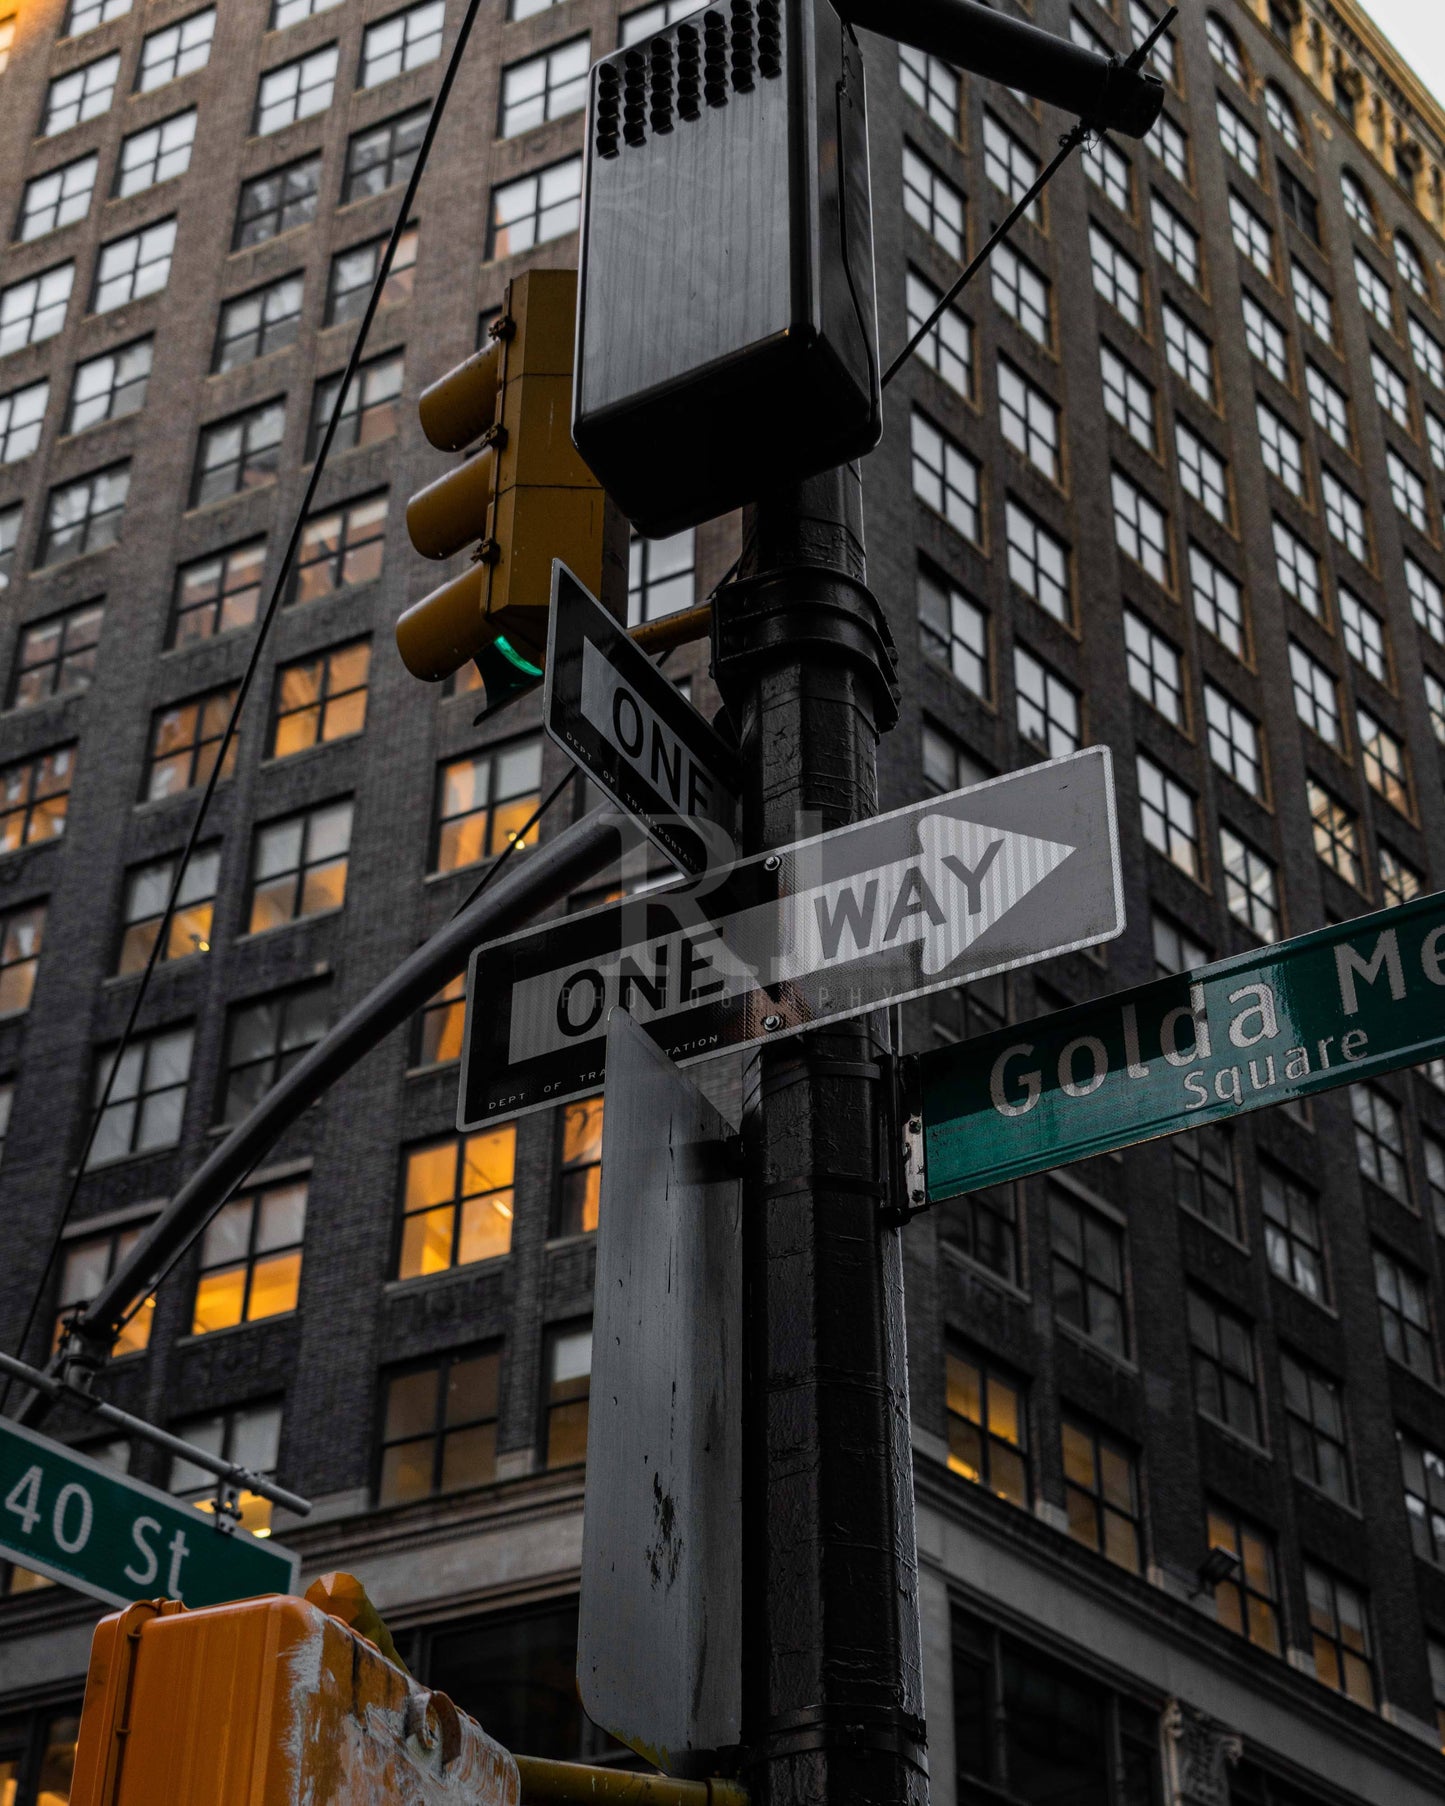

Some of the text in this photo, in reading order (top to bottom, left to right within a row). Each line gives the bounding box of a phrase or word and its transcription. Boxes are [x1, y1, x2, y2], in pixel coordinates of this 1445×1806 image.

[612, 687, 714, 844] ONE
[556, 838, 1005, 1038] ONE WAY
[488, 1092, 526, 1110] DEPT
[543, 1081, 562, 1093] OF
[989, 980, 1280, 1117] Golda
[4, 1464, 94, 1554] 40
[124, 1515, 190, 1601] St
